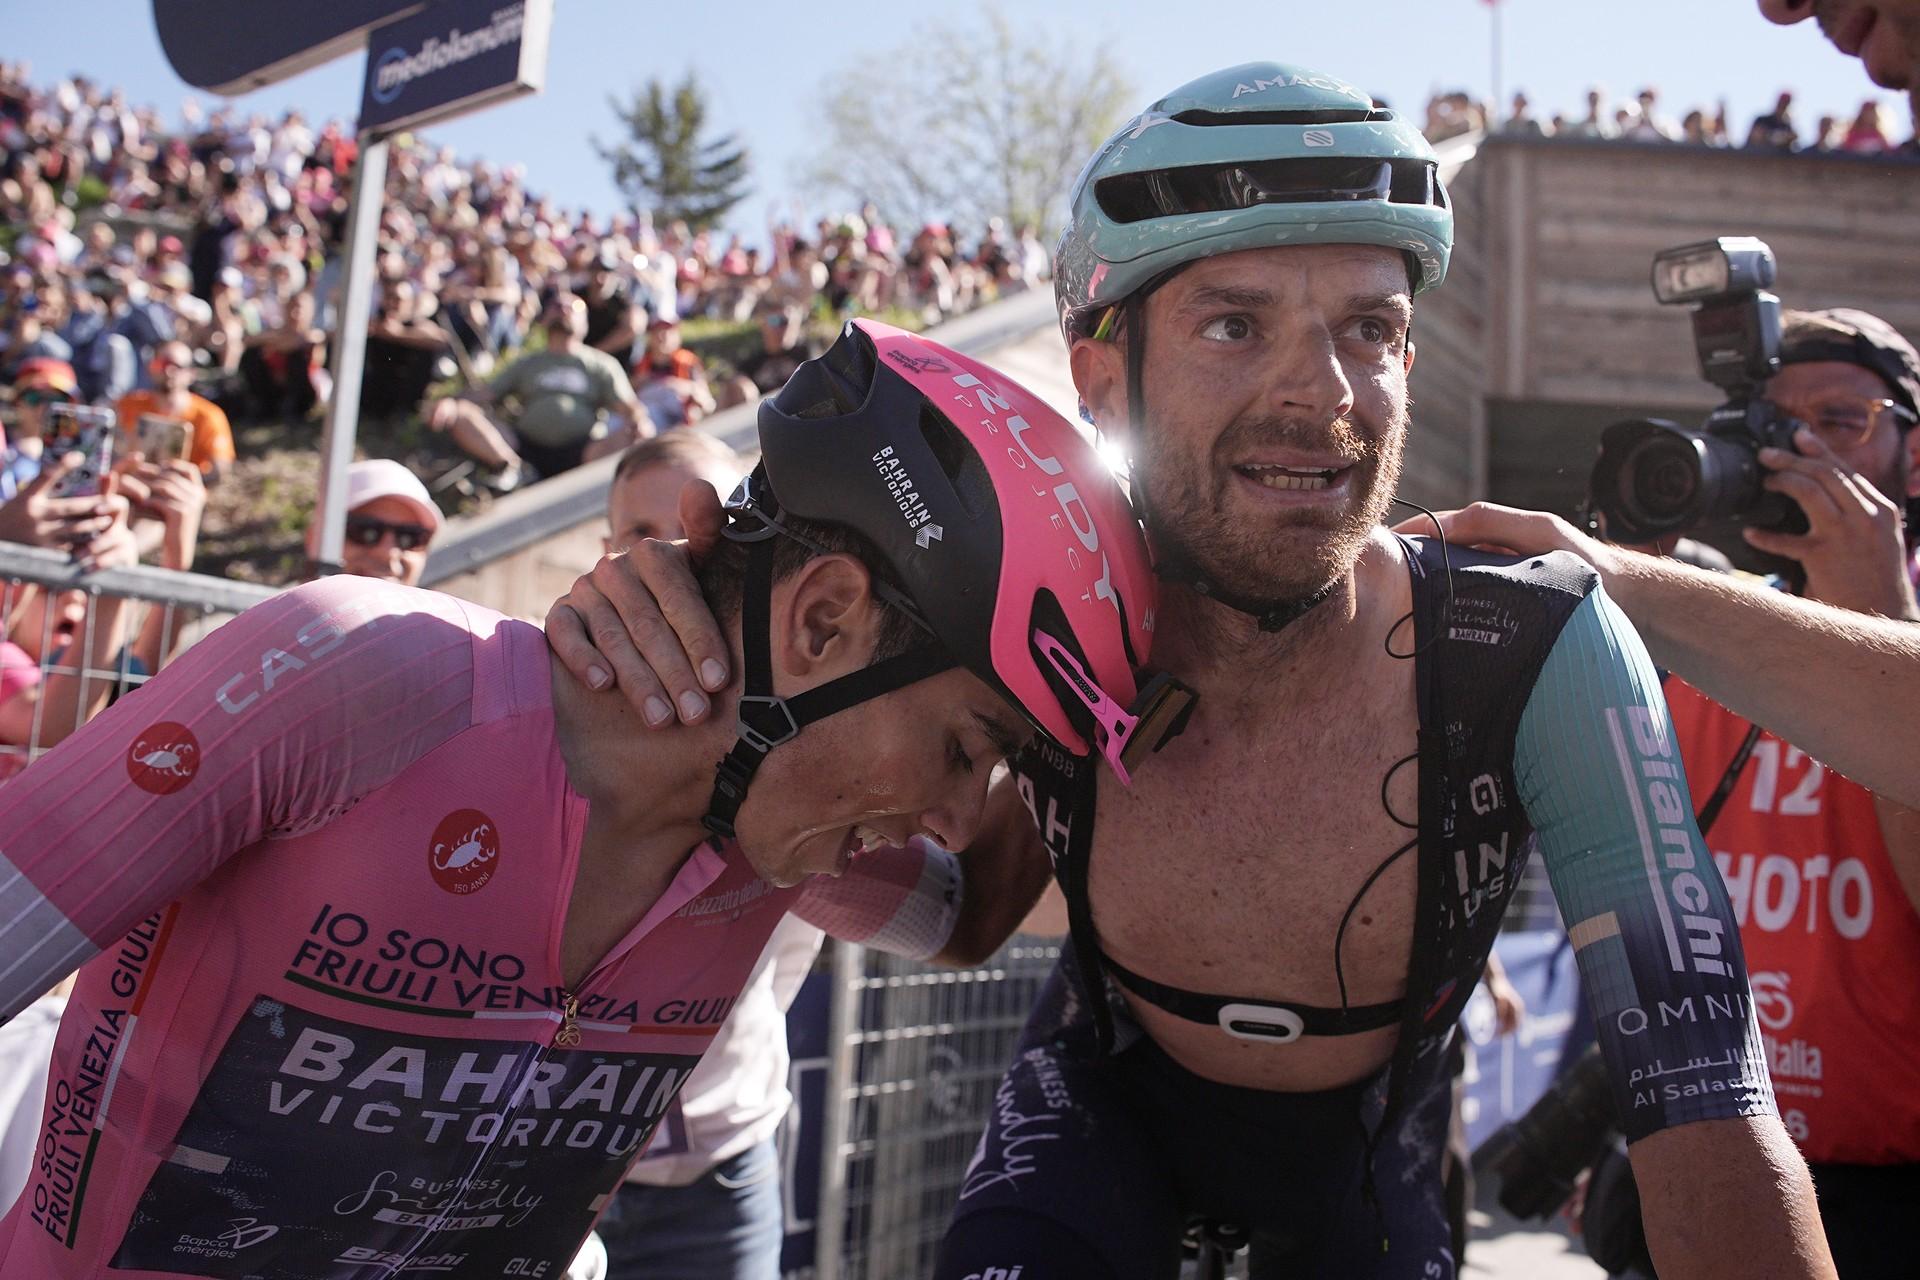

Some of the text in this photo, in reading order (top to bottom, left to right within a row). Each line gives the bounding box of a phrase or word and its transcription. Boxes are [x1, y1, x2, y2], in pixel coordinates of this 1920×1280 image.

[1232, 73, 1361, 99] AMACX
[872, 452, 919, 529] VICTORIOUS
[880, 445, 931, 523] BAHRAIN
[952, 373, 1120, 614] RUDY
[1750, 740, 1825, 816] 12
[1627, 705, 1735, 980] Bianchi
[470, 871, 490, 892] ANNI
[1714, 851, 1874, 941] HOTO
[291, 938, 438, 1003] FRIULI
[310, 903, 526, 982] IO SONO
[278, 1027, 693, 1118] BAHRAIN
[1633, 1088, 1657, 1110] Al
[31, 1079, 71, 1225] IO SONO
[45, 1144, 82, 1243] FRIULI
[64, 1008, 127, 1137] VENEZIA
[409, 1176, 502, 1195] BUSINESS
[172, 1244, 238, 1260] energies
[177, 1234, 229, 1249] Bapco
